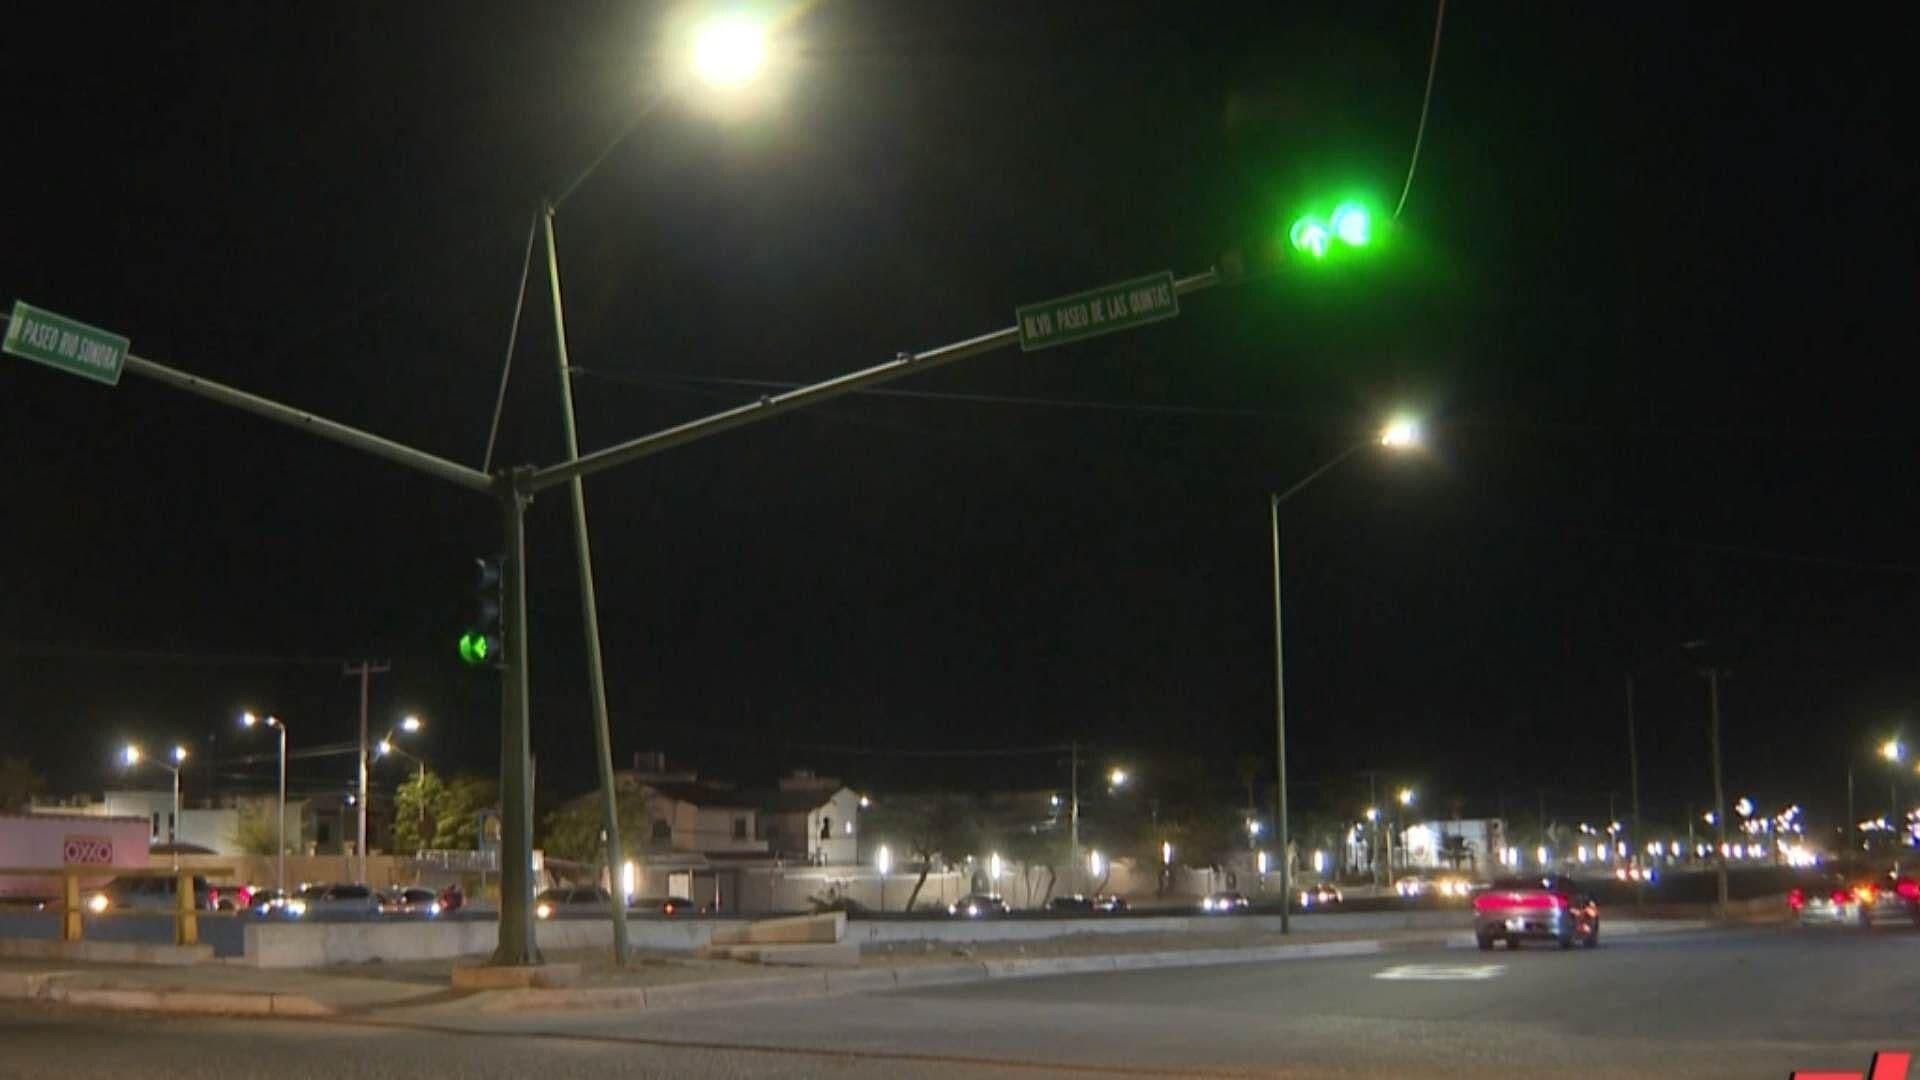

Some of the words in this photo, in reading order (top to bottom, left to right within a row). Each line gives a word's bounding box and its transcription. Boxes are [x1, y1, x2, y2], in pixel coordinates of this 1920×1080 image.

[1056, 303, 1089, 331] PASEO
[1090, 299, 1104, 324] DE
[1106, 293, 1129, 321] LAS
[22, 318, 59, 352] PASEO
[77, 337, 119, 371] SONORA
[64, 842, 112, 863] OXXO
